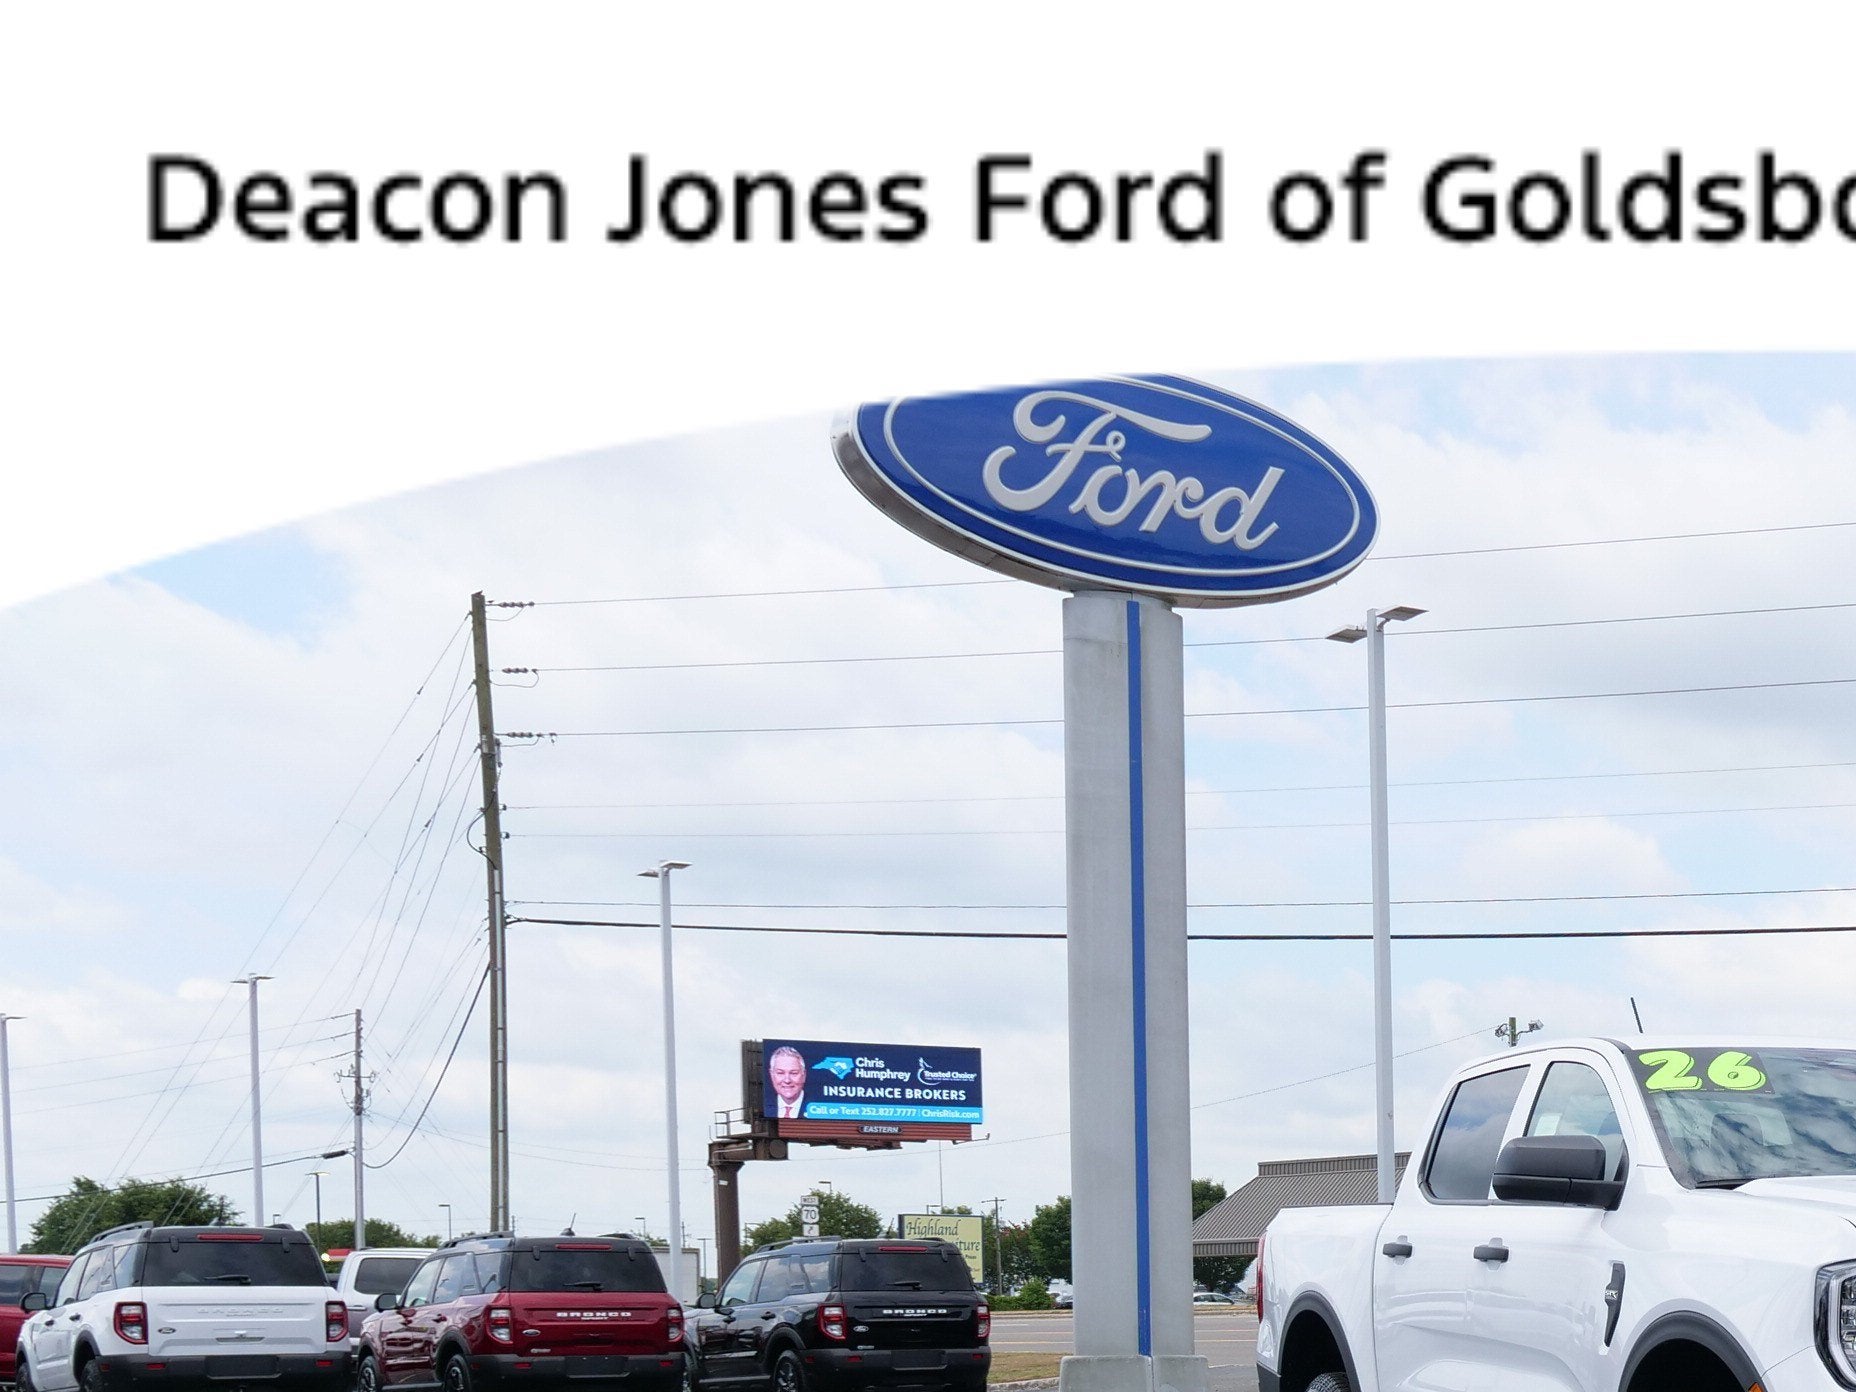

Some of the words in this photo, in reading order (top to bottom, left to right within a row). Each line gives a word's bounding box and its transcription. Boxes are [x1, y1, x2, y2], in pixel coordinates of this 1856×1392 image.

[982, 390, 1286, 551] Ford
[855, 1057, 885, 1068] Chris
[855, 1068, 911, 1082] Humphrey
[923, 1070, 951, 1078] Trusted
[1638, 1050, 1767, 1092] 26
[823, 1085, 902, 1098] INSURANCE
[905, 1088, 966, 1101] BROKERS
[809, 1106, 828, 1115] Call
[840, 1106, 860, 1115] Text
[861, 1107, 917, 1116] 252.827.7777
[921, 1108, 980, 1119] ChrisRisk.com
[804, 1209, 817, 1219] 70
[906, 1217, 961, 1238] Highland
